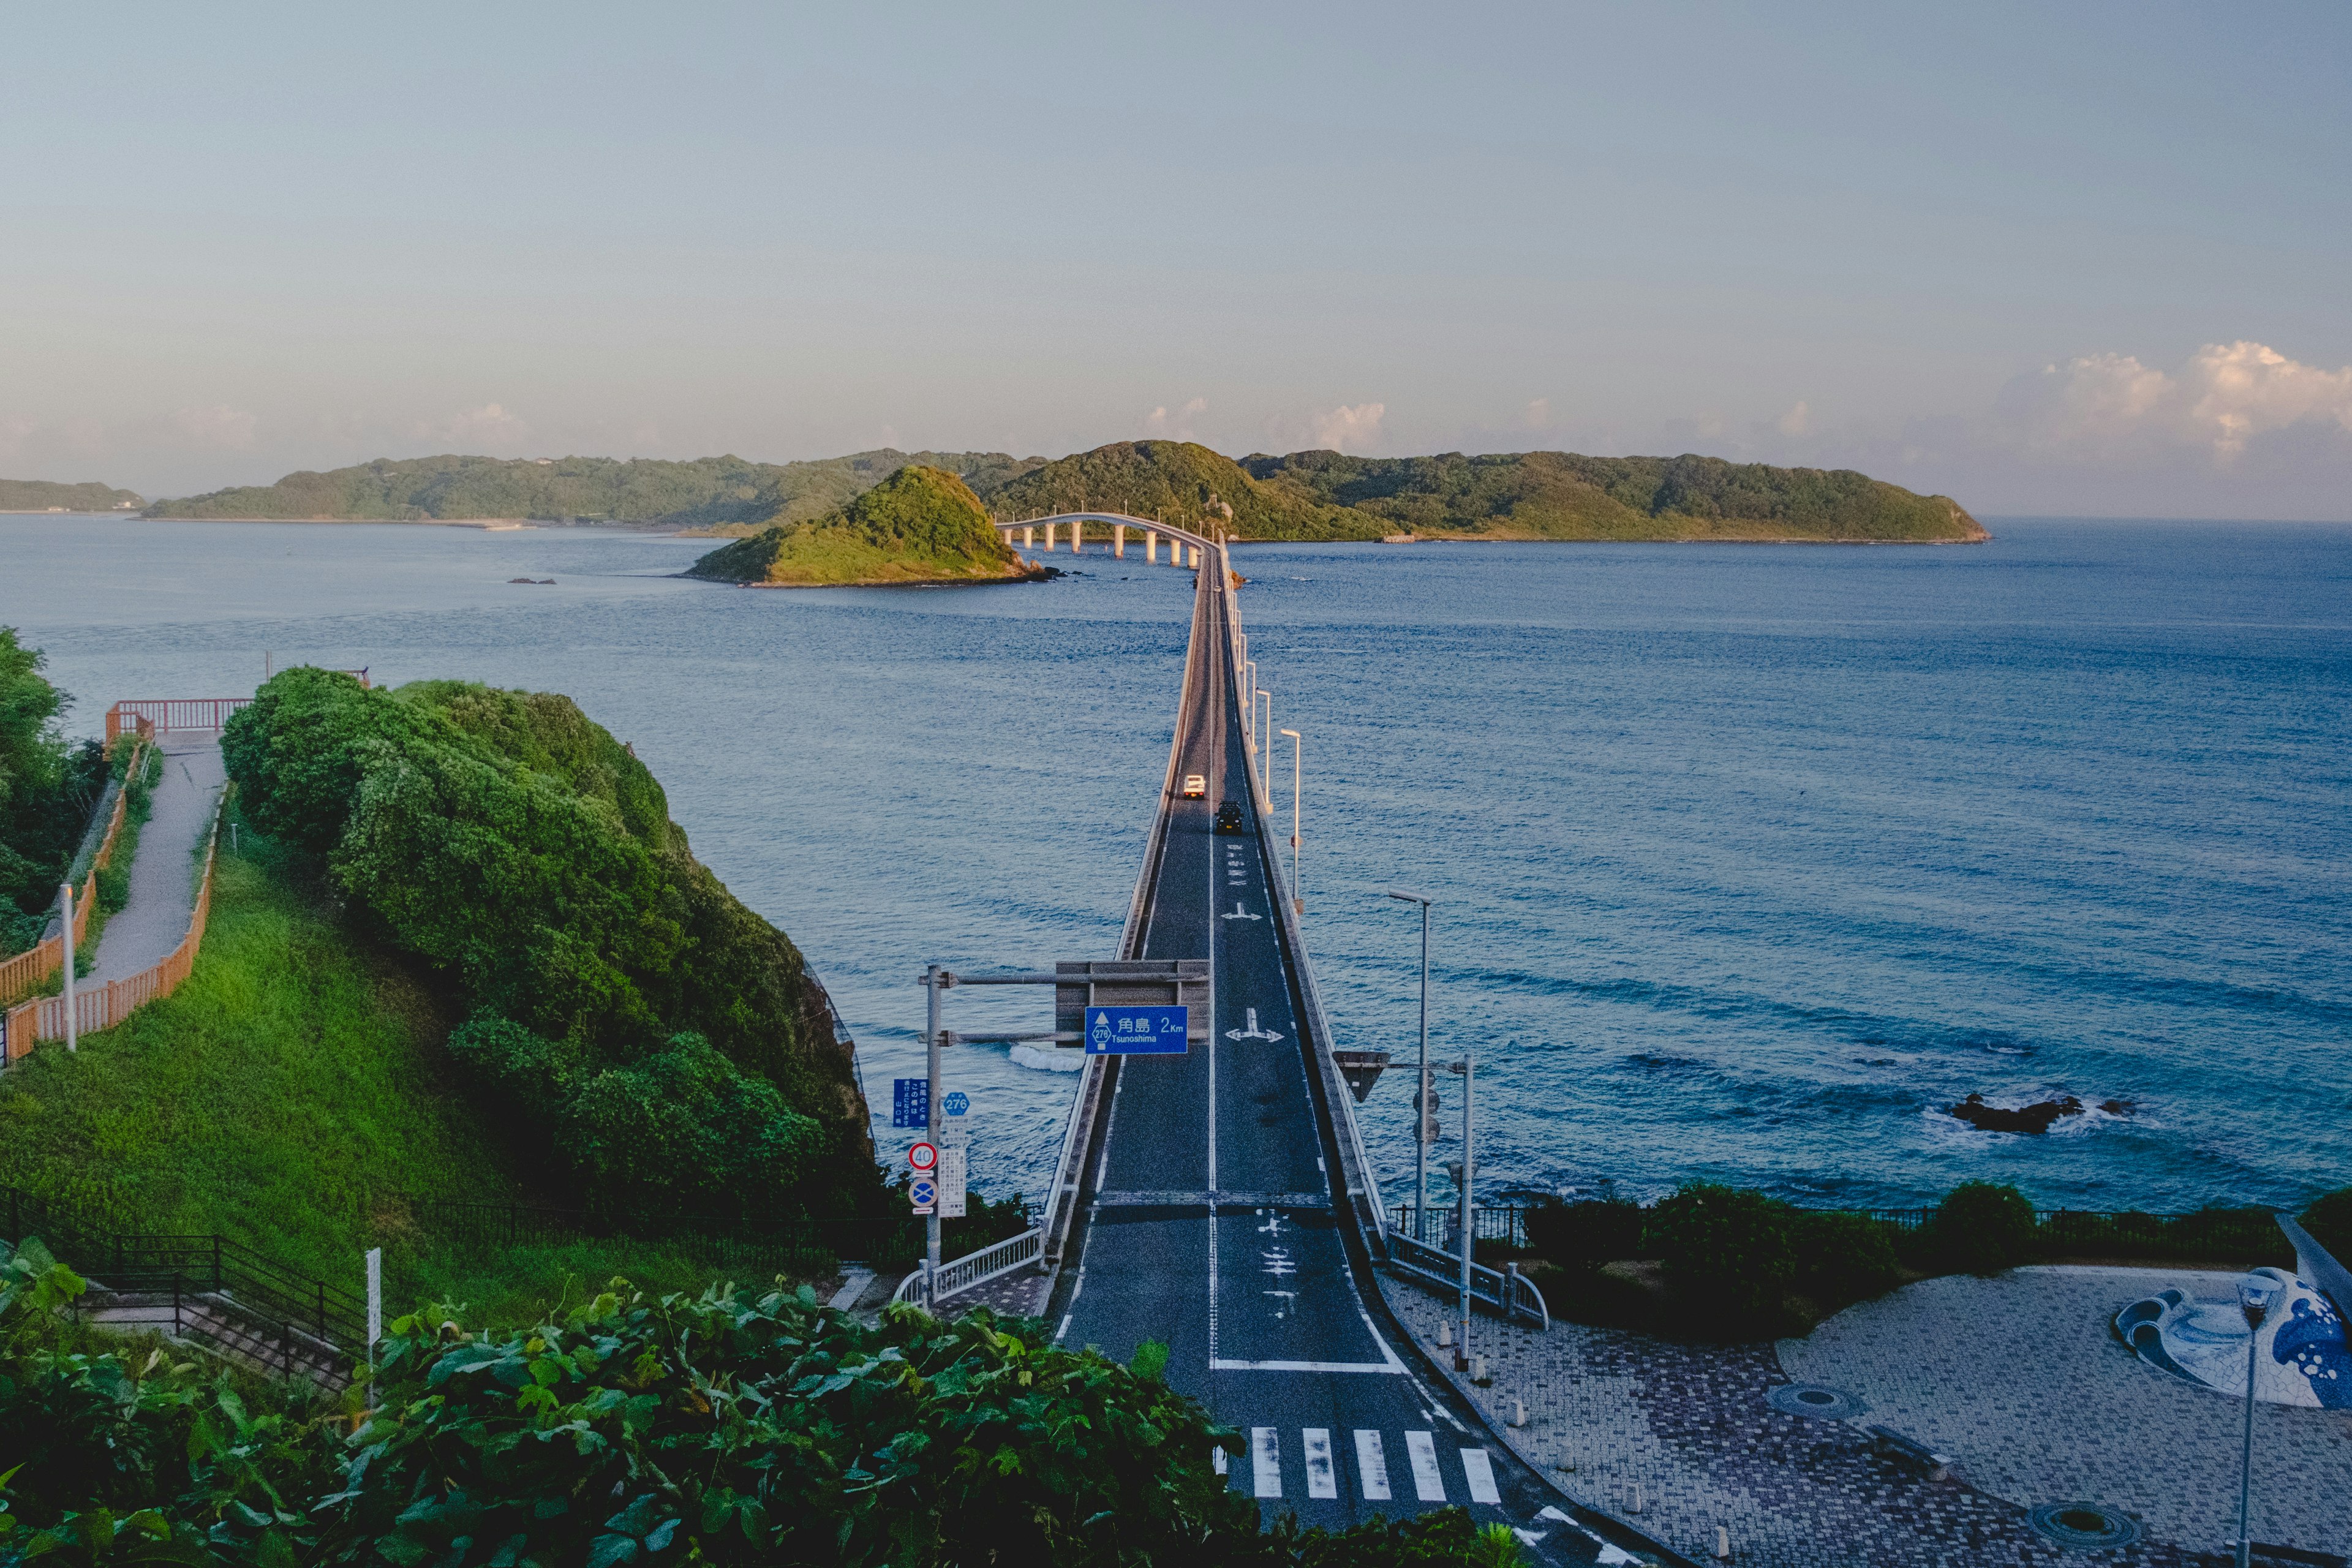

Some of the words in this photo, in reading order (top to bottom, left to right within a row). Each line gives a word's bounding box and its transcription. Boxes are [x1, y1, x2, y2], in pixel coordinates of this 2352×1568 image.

[1118, 1018, 1150, 1033] 角島
[1095, 1030, 1109, 1039] 276
[1112, 1035, 1156, 1043] Tsunoshima
[946, 1099, 967, 1110] 276
[916, 1150, 931, 1163] 40
